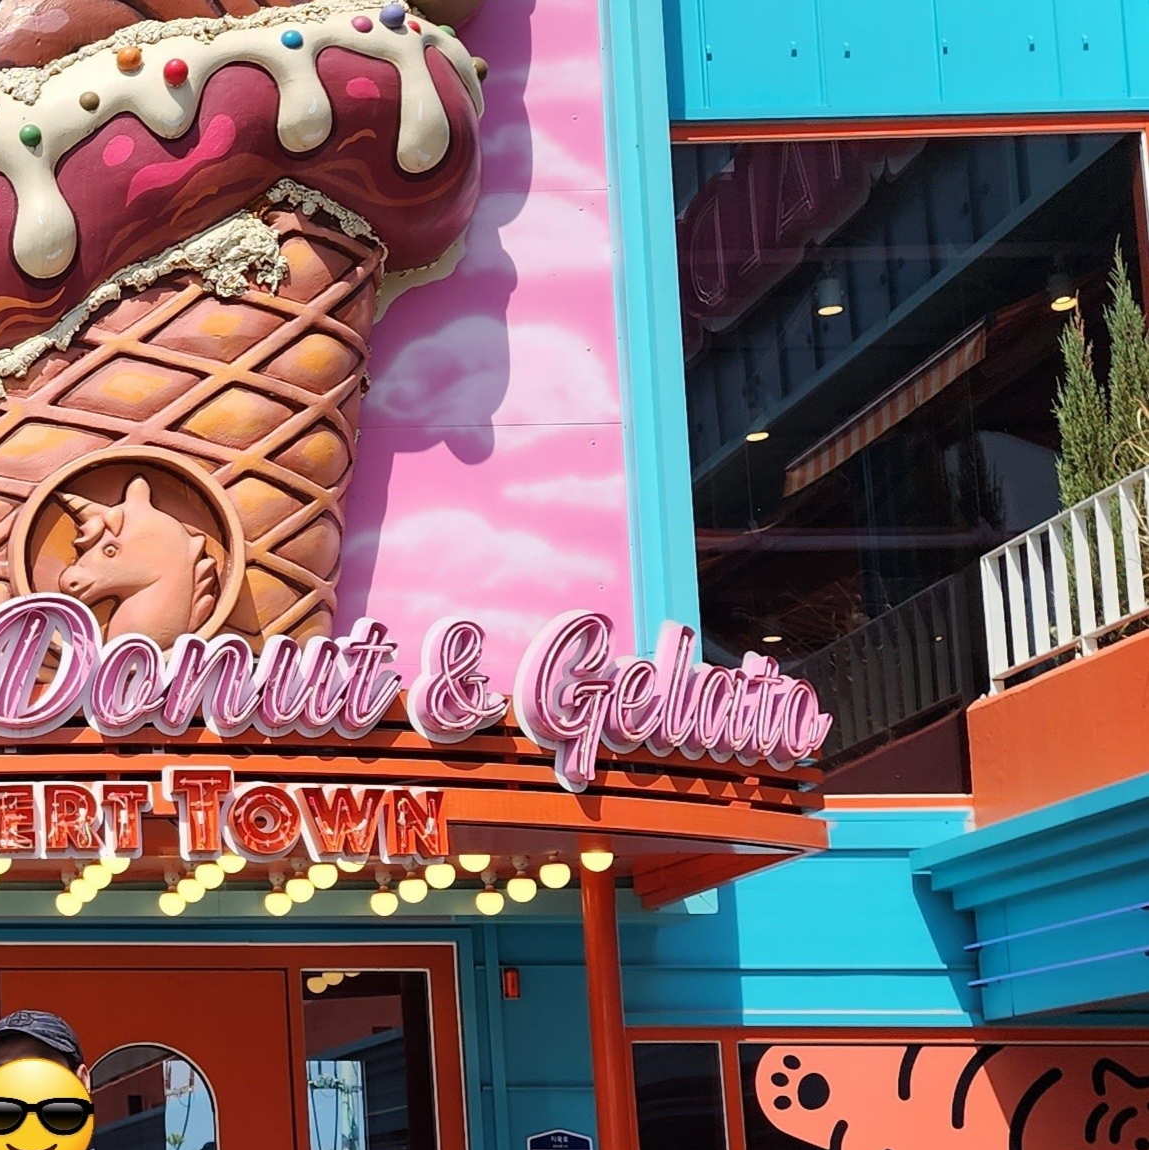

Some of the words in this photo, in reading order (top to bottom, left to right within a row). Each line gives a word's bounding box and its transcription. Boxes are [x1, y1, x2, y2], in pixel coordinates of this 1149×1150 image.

[409, 617, 506, 742] &
[516, 609, 833, 793] Gelato
[163, 766, 450, 865] TOWN
